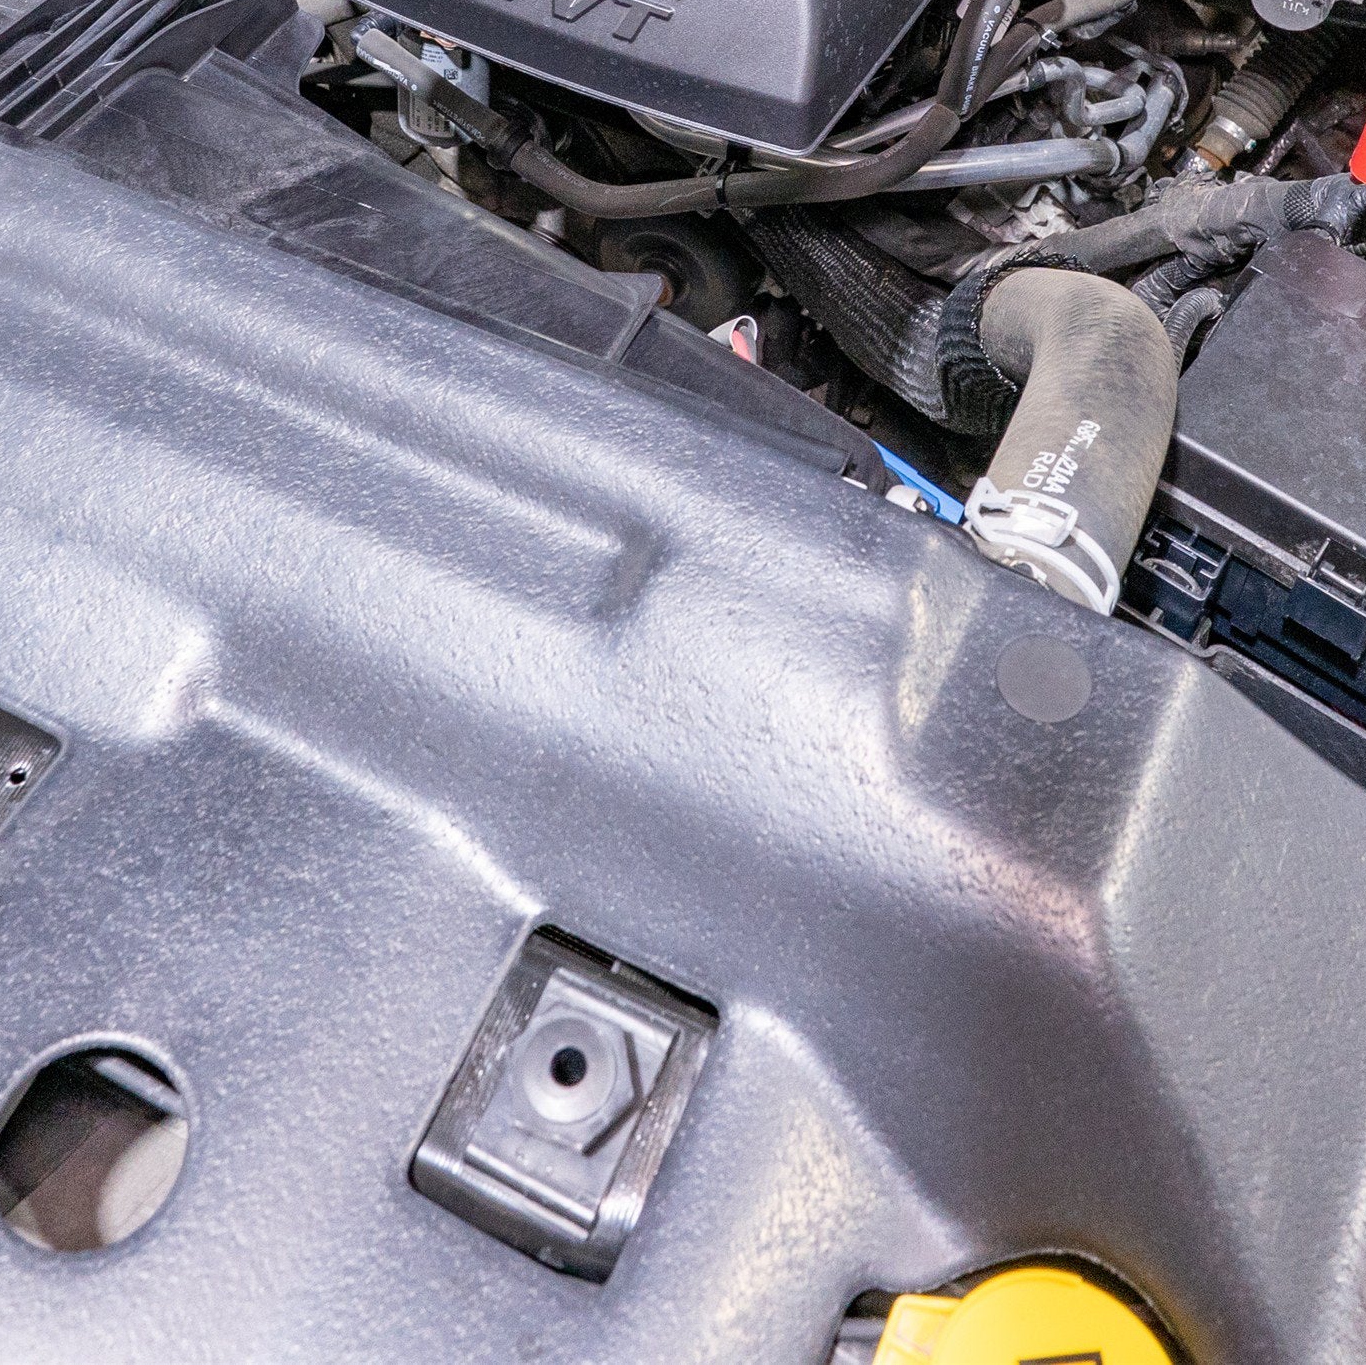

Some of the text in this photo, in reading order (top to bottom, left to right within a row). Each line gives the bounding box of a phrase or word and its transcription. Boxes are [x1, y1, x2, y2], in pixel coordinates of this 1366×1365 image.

[974, 19, 996, 62] VACUUM
[966, 66, 979, 93] BRAKE
[1022, 450, 1058, 488] RAD
